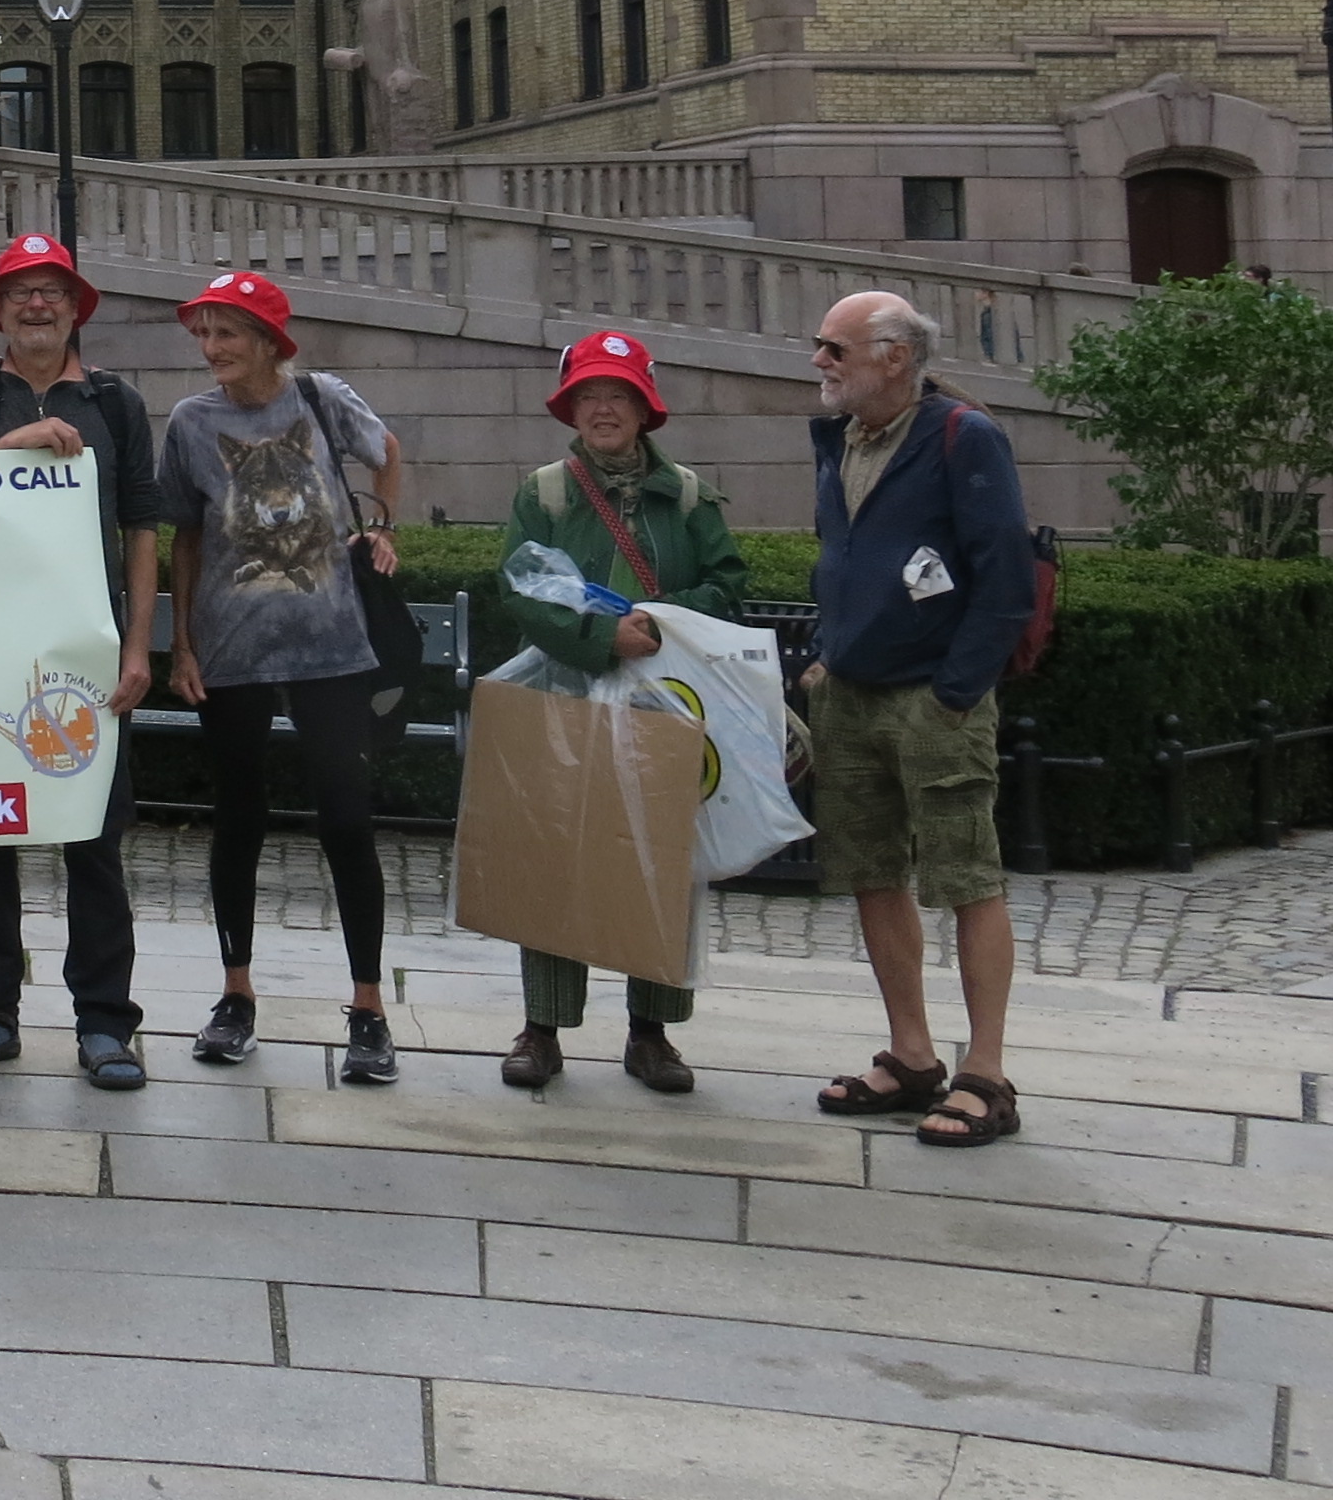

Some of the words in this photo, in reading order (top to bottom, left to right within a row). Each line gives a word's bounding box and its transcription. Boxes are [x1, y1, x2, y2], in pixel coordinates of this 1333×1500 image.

[9, 464, 81, 491] CALL
[42, 672, 58, 684] NO
[64, 672, 107, 704] THANKS
